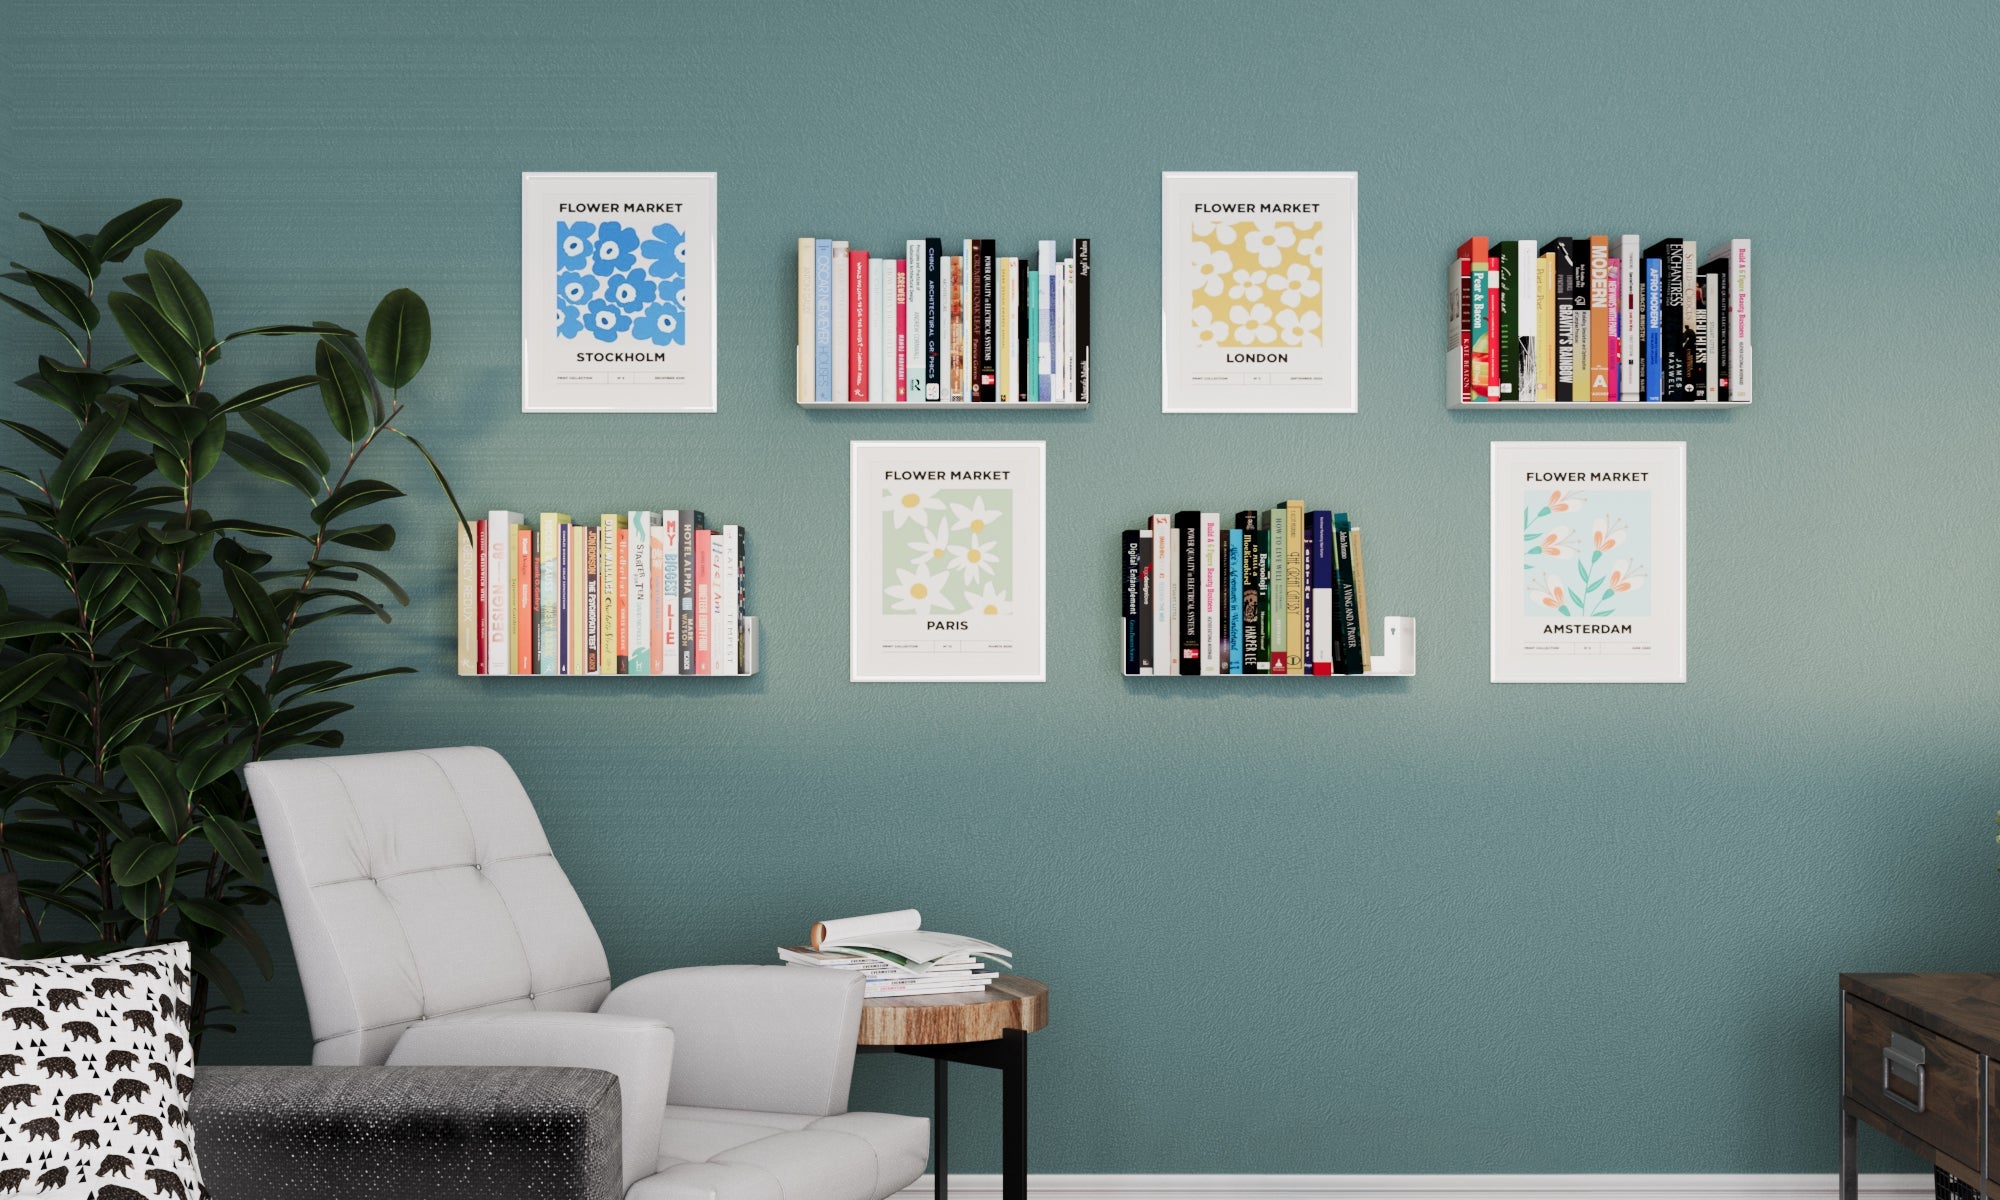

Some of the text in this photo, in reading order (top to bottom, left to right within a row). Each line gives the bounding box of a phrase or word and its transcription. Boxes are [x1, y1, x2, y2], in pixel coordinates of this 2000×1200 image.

[559, 203, 683, 213] FLOWER MARKET
[1194, 203, 1320, 213] FLOWER MARKET
[984, 255, 992, 273] POWER
[1670, 244, 1683, 307] ENCHANTRESS
[897, 271, 905, 305] SCREWED!
[984, 274, 992, 297] QUALITY
[1591, 245, 1607, 309] MODERN
[973, 298, 981, 314] OAK
[1474, 272, 1484, 329] Pear & Bacon
[1608, 281, 1616, 338] NEW WAYS WITH PAINT
[1650, 268, 1659, 329] AFRO MODERN
[1737, 294, 1746, 313] Beauty
[818, 255, 830, 387] OSCAR NIEMEYER HOUSES
[973, 316, 981, 335] LEAF
[984, 303, 992, 335] ELECTRICAL
[984, 336, 992, 361] SYSTEMS
[1559, 304, 1573, 384] GRAVITY'S RAINBOW
[577, 353, 666, 362] STOCKHOLM
[928, 340, 938, 379] GRAPHICS
[1226, 354, 1288, 363] LONDON
[885, 471, 1010, 481] FLOWER MARKET
[1526, 472, 1649, 482] FLOWER MARKET
[588, 531, 597, 545] JON
[1186, 528, 1195, 547] POWER
[1208, 522, 1216, 536] Build
[1339, 530, 1347, 543] John
[1276, 537, 1283, 546] TO
[588, 546, 597, 575] RONSON
[604, 519, 615, 594] DANNY WALLACE
[684, 524, 694, 595] HOTEL ALPHA
[1128, 543, 1138, 566] Digital
[1186, 548, 1195, 572] QUALITY
[1231, 544, 1240, 565] Alice's
[1287, 551, 1300, 565] THE
[635, 543, 645, 600] STARTER TEN
[664, 553, 678, 597] BIGGEST
[1206, 567, 1216, 588] Beauty
[1259, 553, 1268, 591] Bayooloji
[1287, 567, 1300, 589] GREAT
[588, 580, 597, 592] THE
[1128, 568, 1138, 615] Entanglement
[1186, 578, 1195, 611] ELECTRICAL
[1231, 567, 1240, 604] Adventures
[463, 585, 473, 623] REDUX
[713, 592, 723, 616] Am
[1208, 588, 1216, 613] Business
[1287, 590, 1300, 616] GATSBY
[1343, 588, 1353, 608] WING
[588, 593, 597, 634] PSYCHOPATH
[1186, 612, 1195, 636] SYSTEMS
[1345, 608, 1354, 621] AND
[927, 621, 968, 631] PARIS
[1231, 614, 1240, 651] Wonderland
[1348, 627, 1357, 649] PRAYER
[1543, 625, 1632, 634] AMSTERDAM
[588, 635, 597, 650] TEST
[1245, 626, 1257, 666] HARPER LEE
